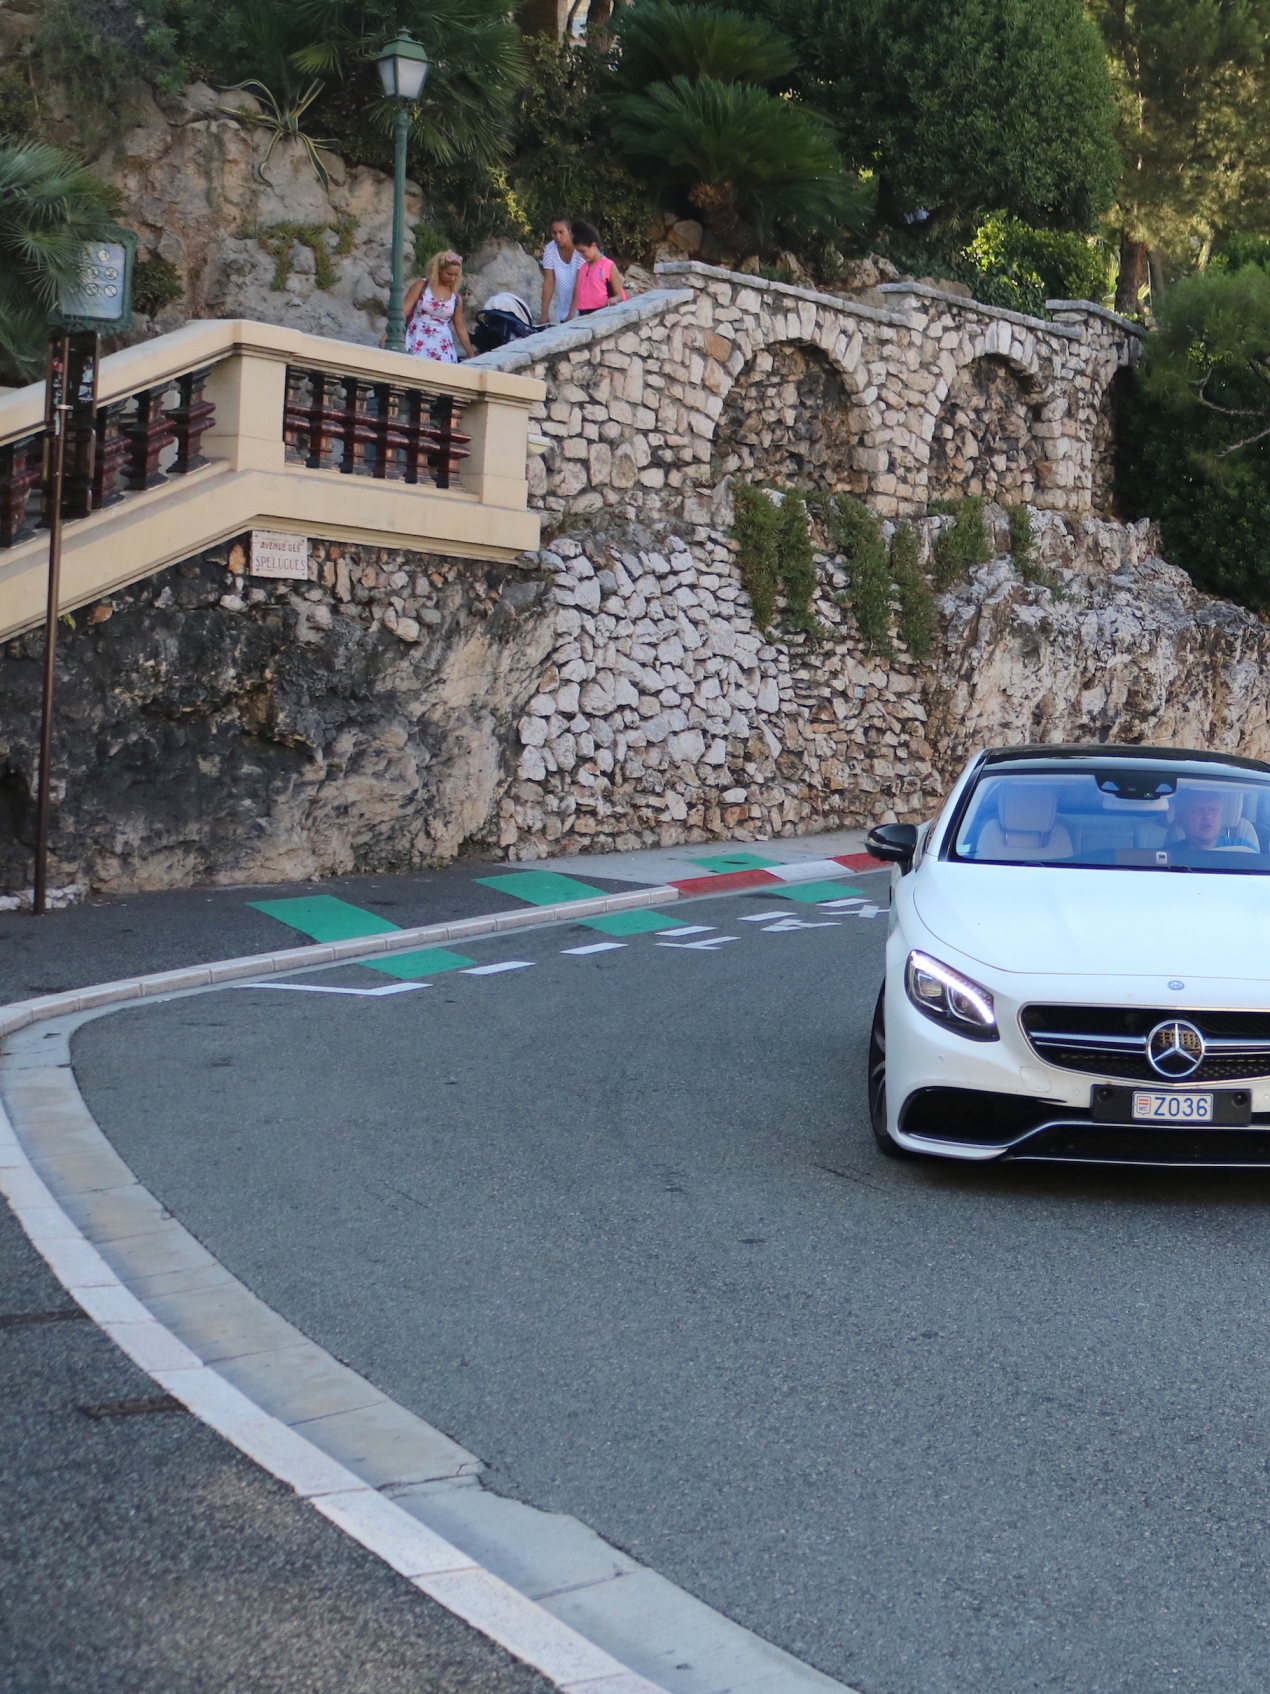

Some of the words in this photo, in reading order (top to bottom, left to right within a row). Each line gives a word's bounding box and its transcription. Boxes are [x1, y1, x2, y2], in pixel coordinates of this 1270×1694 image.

[260, 541, 286, 552] AVENUE
[288, 543, 301, 553] DES
[255, 555, 306, 571] SPELUGUES
[1154, 1097, 1208, 1117] Z036
